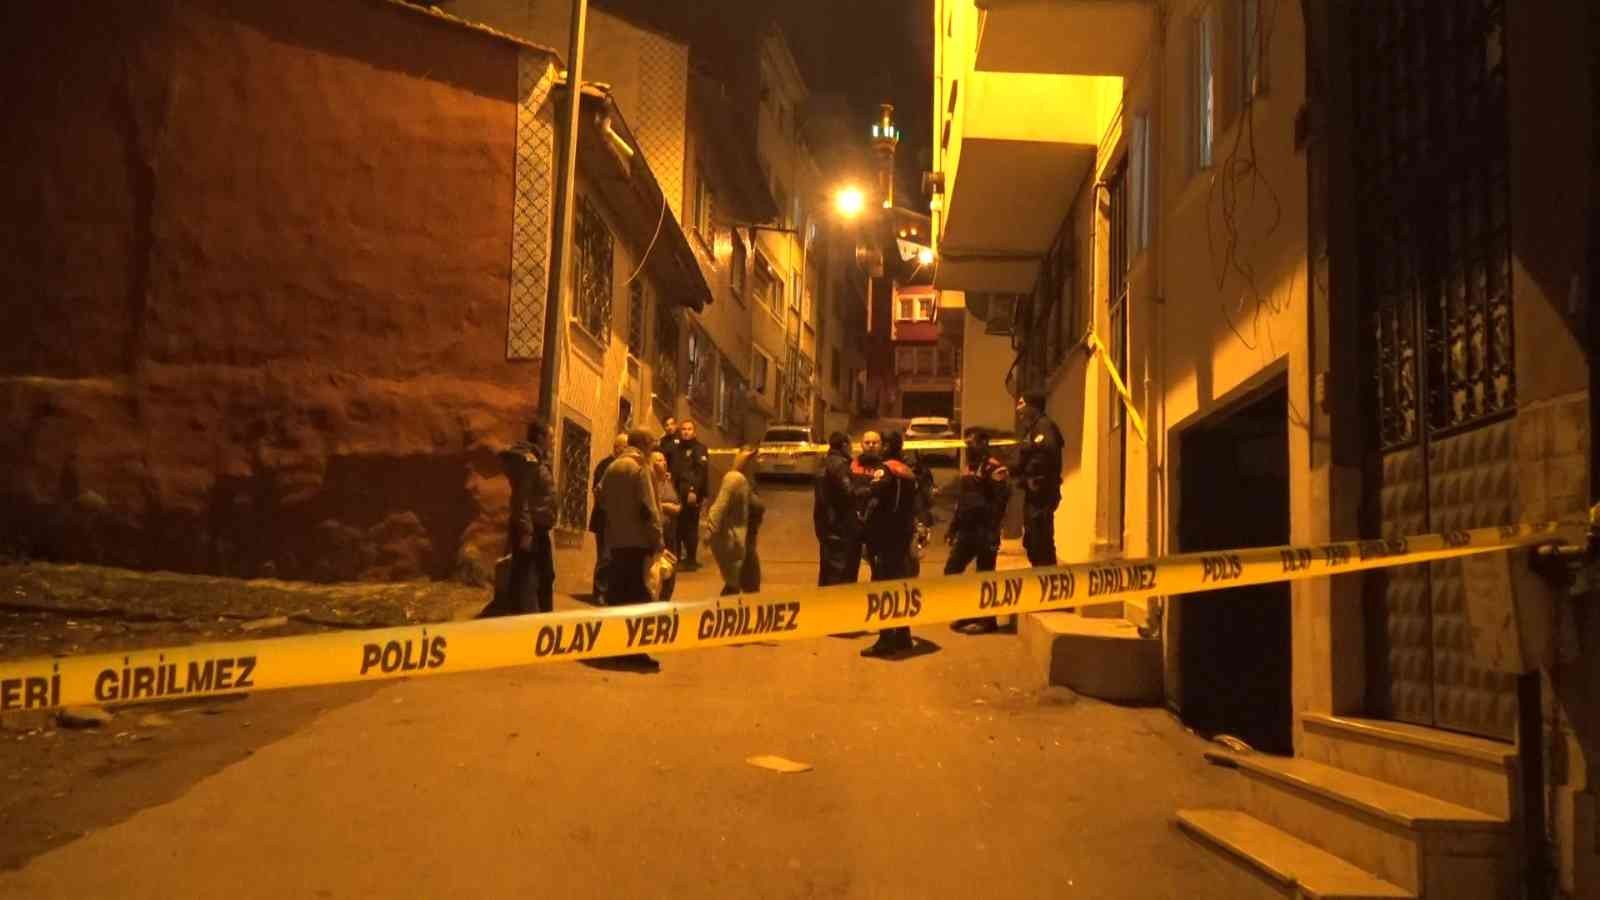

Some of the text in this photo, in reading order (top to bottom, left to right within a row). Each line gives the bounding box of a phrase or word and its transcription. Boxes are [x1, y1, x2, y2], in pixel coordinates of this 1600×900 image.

[94, 654, 257, 703] GİRİLMEZ
[361, 628, 447, 675] POLİS
[535, 622, 602, 657] OLAY
[625, 608, 679, 647] YERİ
[698, 594, 801, 641] GİRİLMEZ
[866, 587, 922, 622] POLİS
[979, 577, 1023, 609] OLAY
[1040, 568, 1075, 602] YERİ
